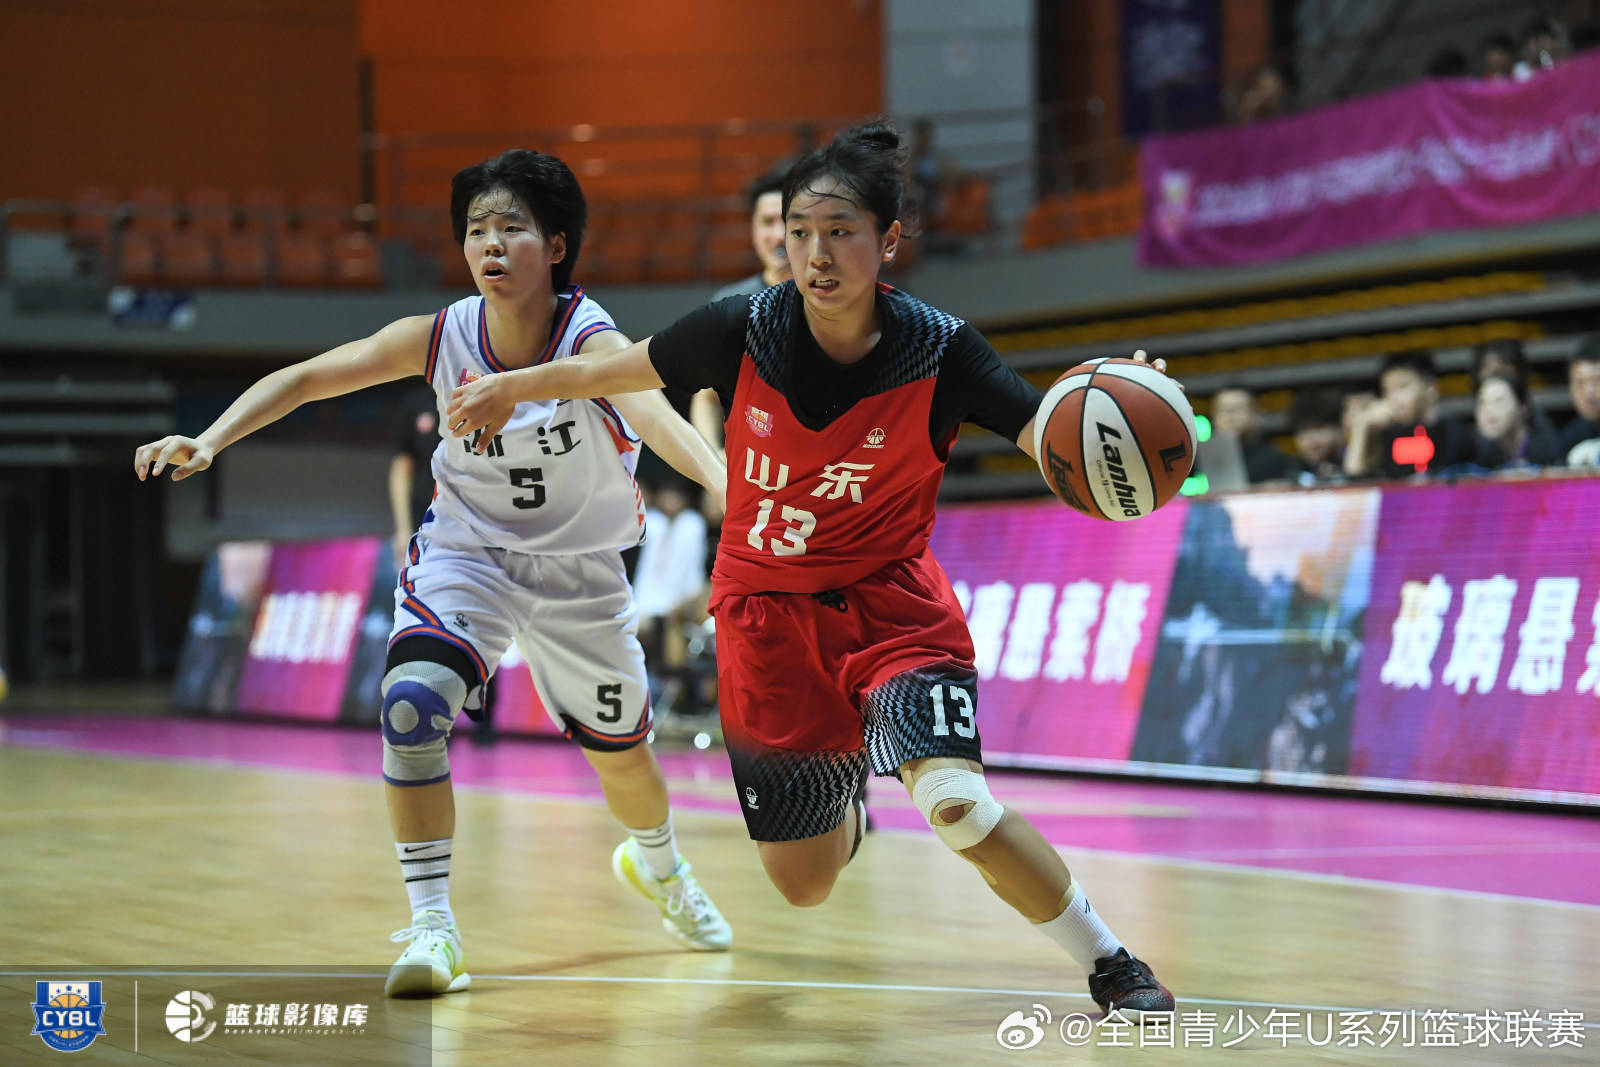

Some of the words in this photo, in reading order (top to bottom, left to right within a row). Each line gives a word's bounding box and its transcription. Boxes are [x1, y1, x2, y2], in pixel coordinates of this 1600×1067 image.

[509, 467, 546, 509] 5
[744, 447, 875, 504] 山东
[1095, 421, 1142, 517] Lanhua
[747, 498, 817, 556] 13
[953, 578, 1151, 684] 璃悬索桥
[596, 684, 622, 723] 5
[929, 683, 976, 739] 13
